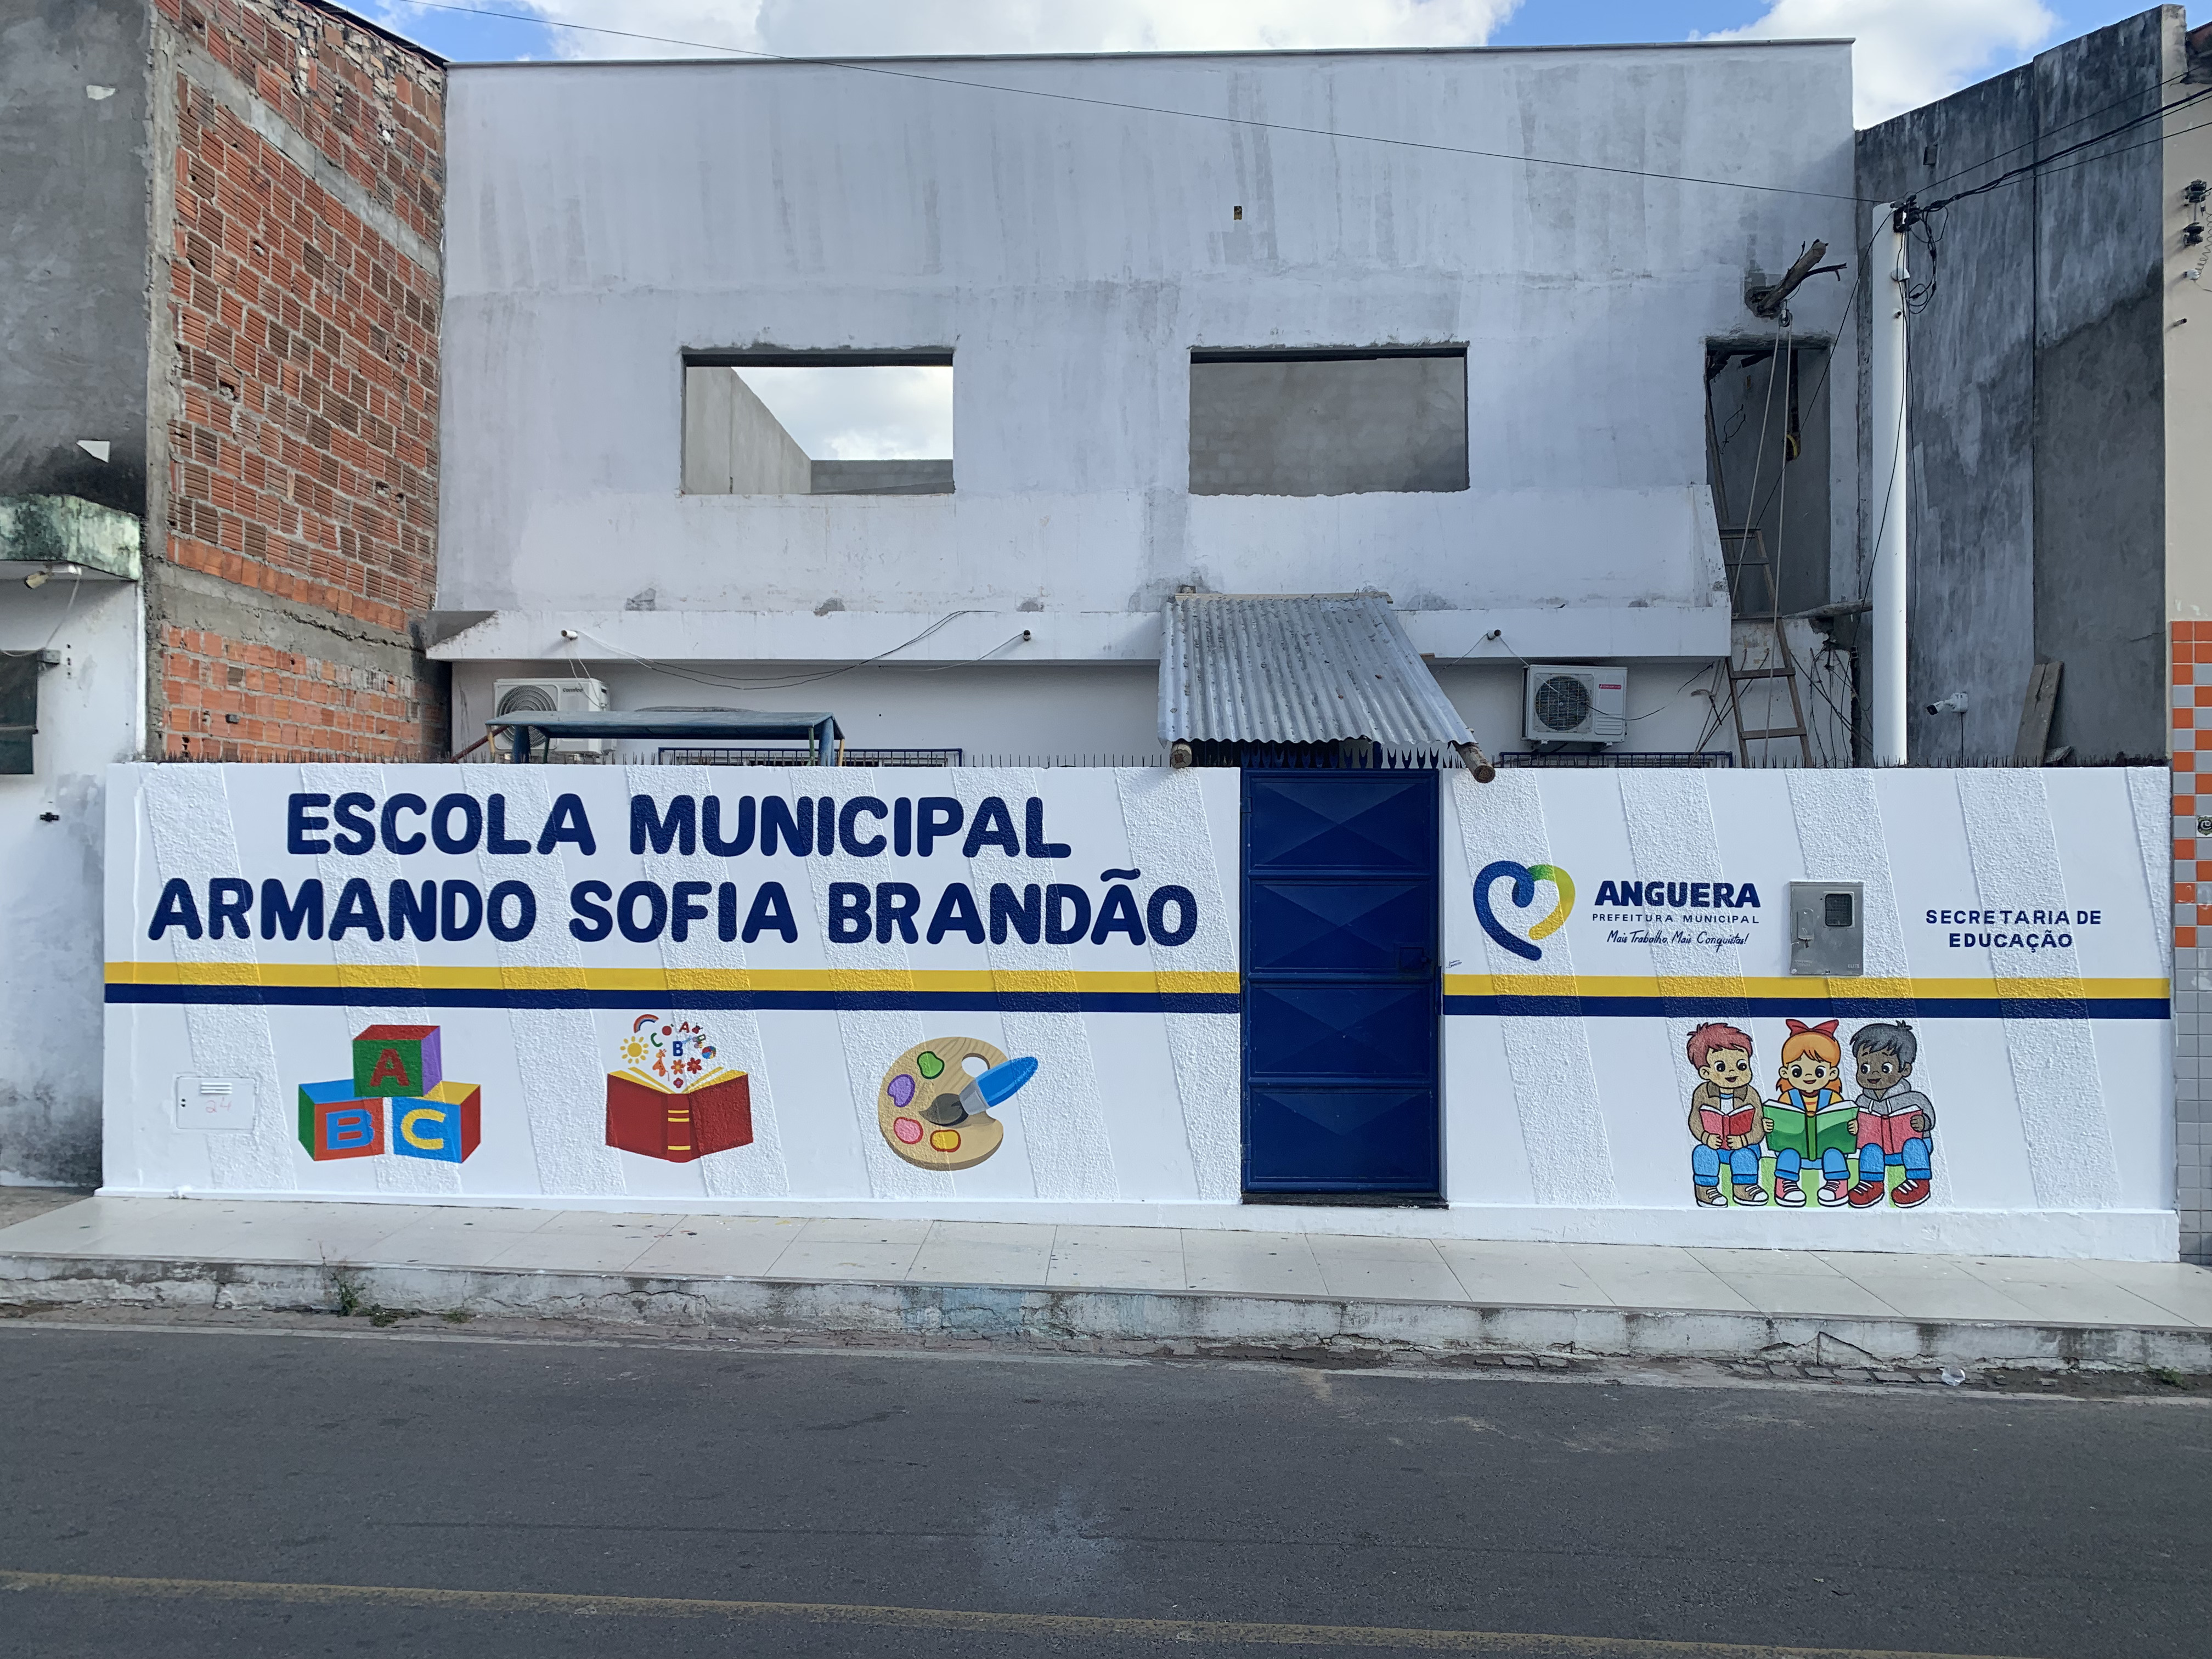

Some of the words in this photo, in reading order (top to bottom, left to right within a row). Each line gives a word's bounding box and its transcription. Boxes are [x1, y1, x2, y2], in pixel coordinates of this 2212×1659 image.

[287, 792, 596, 856] ESCOLA
[630, 794, 1071, 859] MUNICIPAL
[148, 877, 537, 943] ARMANDO
[568, 880, 798, 944] SOFIA
[828, 868, 1198, 947] BRANDÃO
[1594, 880, 1761, 909] ANGUERA
[1593, 913, 1673, 923] PREFEITURA
[1683, 915, 1759, 924] MUNICIPAL
[1926, 910, 2070, 925] SECRETARIA
[2077, 910, 2101, 924] DE
[1607, 930, 1627, 943] Mais
[1629, 930, 1668, 944] Trabalho,
[1671, 930, 1691, 944] Mais
[1696, 931, 1750, 953] Conquistas!
[1949, 929, 2072, 953] EDUCAÇÃO
[678, 1021, 690, 1034] A
[673, 1041, 684, 1057] B
[369, 1048, 410, 1087] A
[325, 1109, 375, 1150] B
[401, 1108, 447, 1150] C
